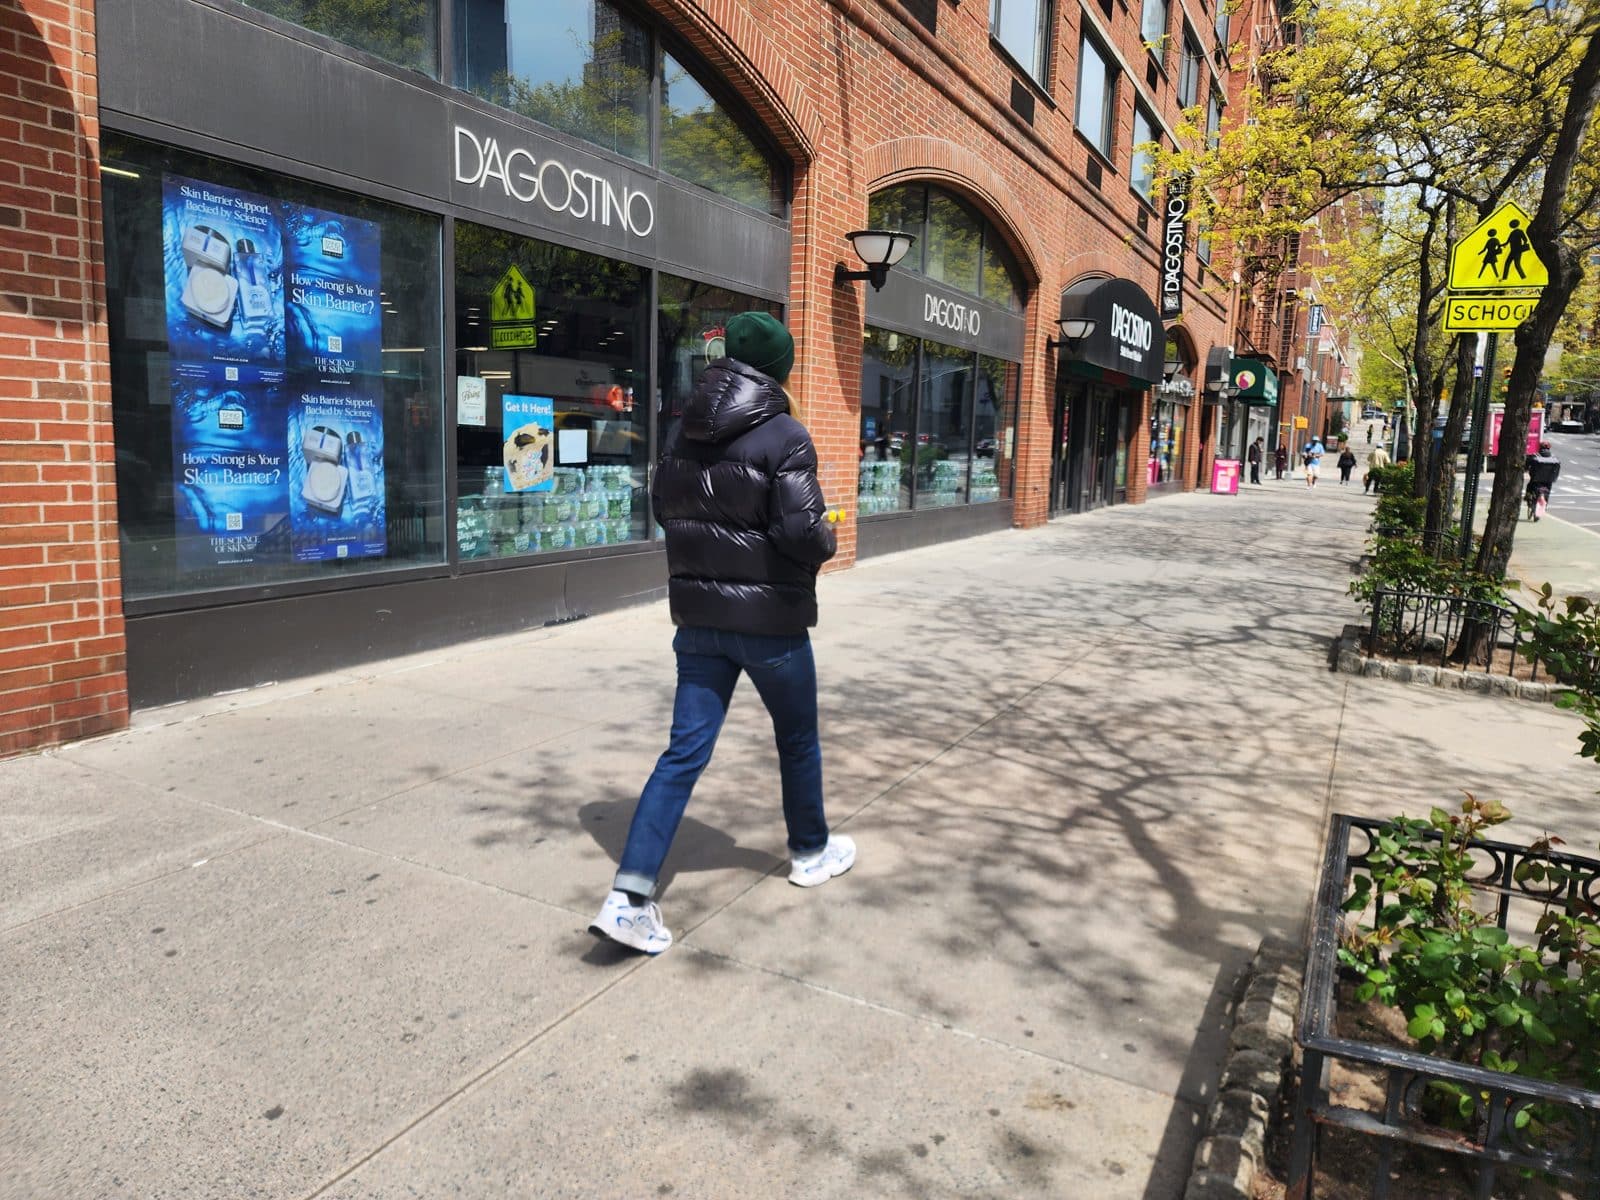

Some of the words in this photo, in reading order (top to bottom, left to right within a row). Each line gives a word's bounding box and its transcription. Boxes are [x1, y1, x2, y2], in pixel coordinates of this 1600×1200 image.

[454, 126, 654, 237] D'AGOSTINO
[180, 185, 201, 200] Skin
[203, 190, 233, 207] Barrier
[186, 199, 219, 216] Backed
[220, 206, 232, 220] by
[234, 211, 267, 226] Science
[291, 272, 313, 286] How
[315, 278, 345, 295] Strong
[346, 282, 354, 293] is
[355, 284, 375, 297] Your
[292, 288, 322, 307] Skin
[325, 293, 375, 315] Barrier?
[301, 393, 319, 404] Skin
[320, 395, 344, 406] Barrier
[505, 402, 520, 412] Get
[522, 403, 529, 412] It
[530, 403, 551, 414] Here!
[305, 405, 333, 415] Backed
[333, 406, 343, 417] by
[345, 407, 372, 417] Science
[182, 452, 206, 465] How
[210, 454, 245, 468] Strong
[247, 454, 256, 465] is
[258, 454, 281, 466] Your
[184, 468, 218, 485] Skin
[223, 468, 281, 485] Barrier?
